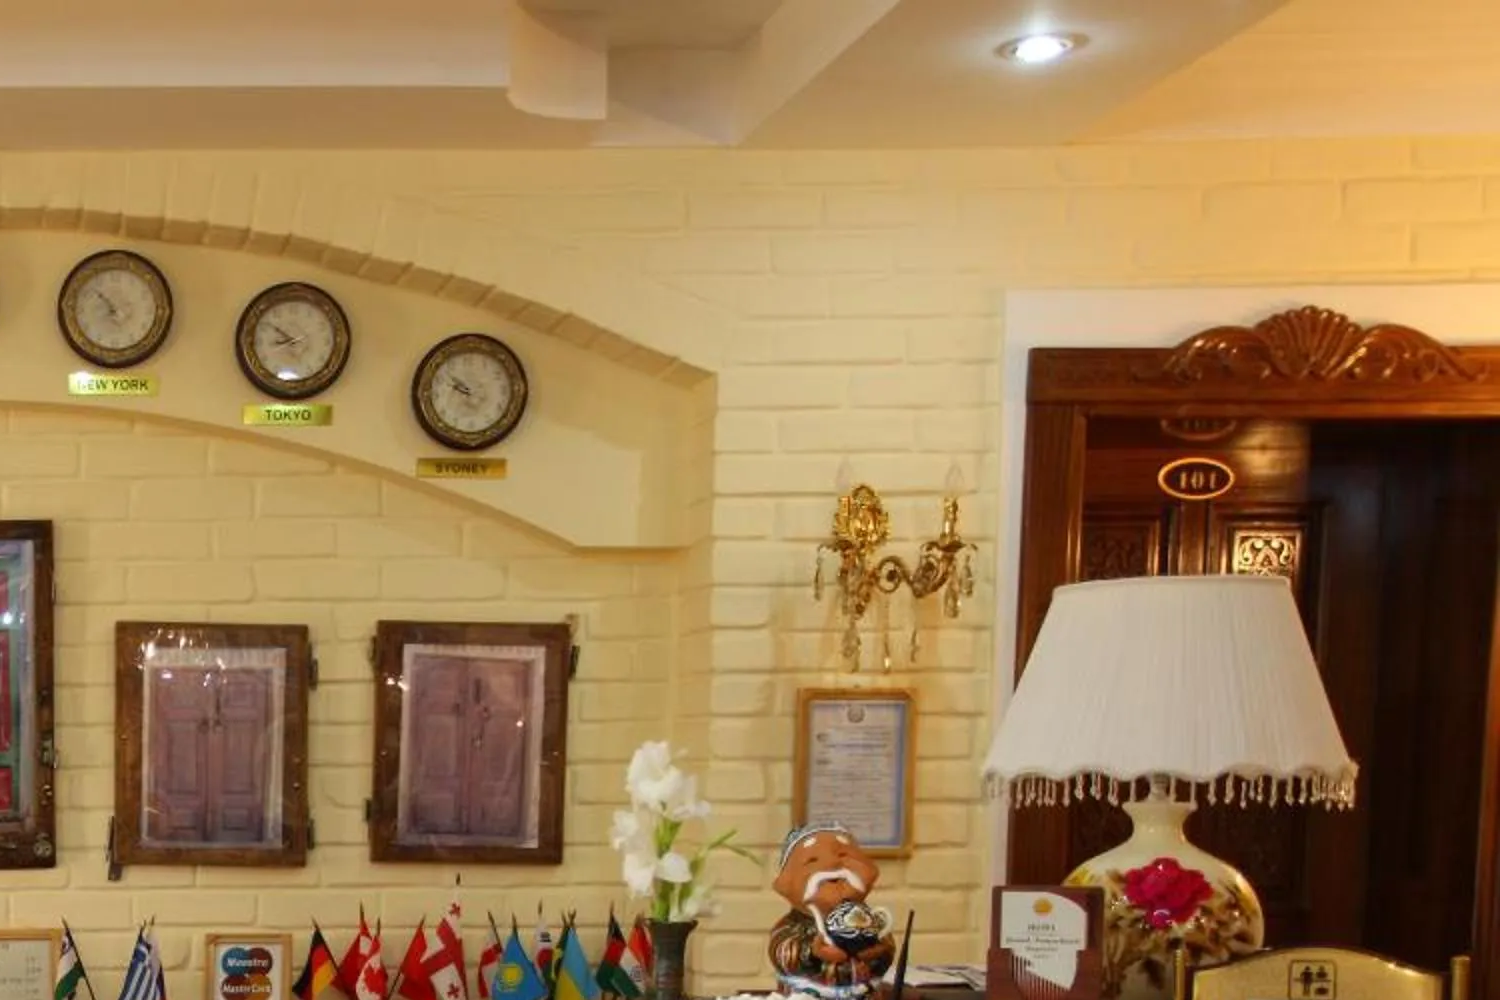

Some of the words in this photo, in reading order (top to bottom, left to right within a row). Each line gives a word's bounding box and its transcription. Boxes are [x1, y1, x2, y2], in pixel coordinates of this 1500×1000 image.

[111, 379, 149, 390] YORK
[264, 409, 312, 421] TOKYO
[435, 462, 489, 475] SYDNEY
[1180, 470, 1217, 489] 101
[226, 957, 269, 967] Maestro
